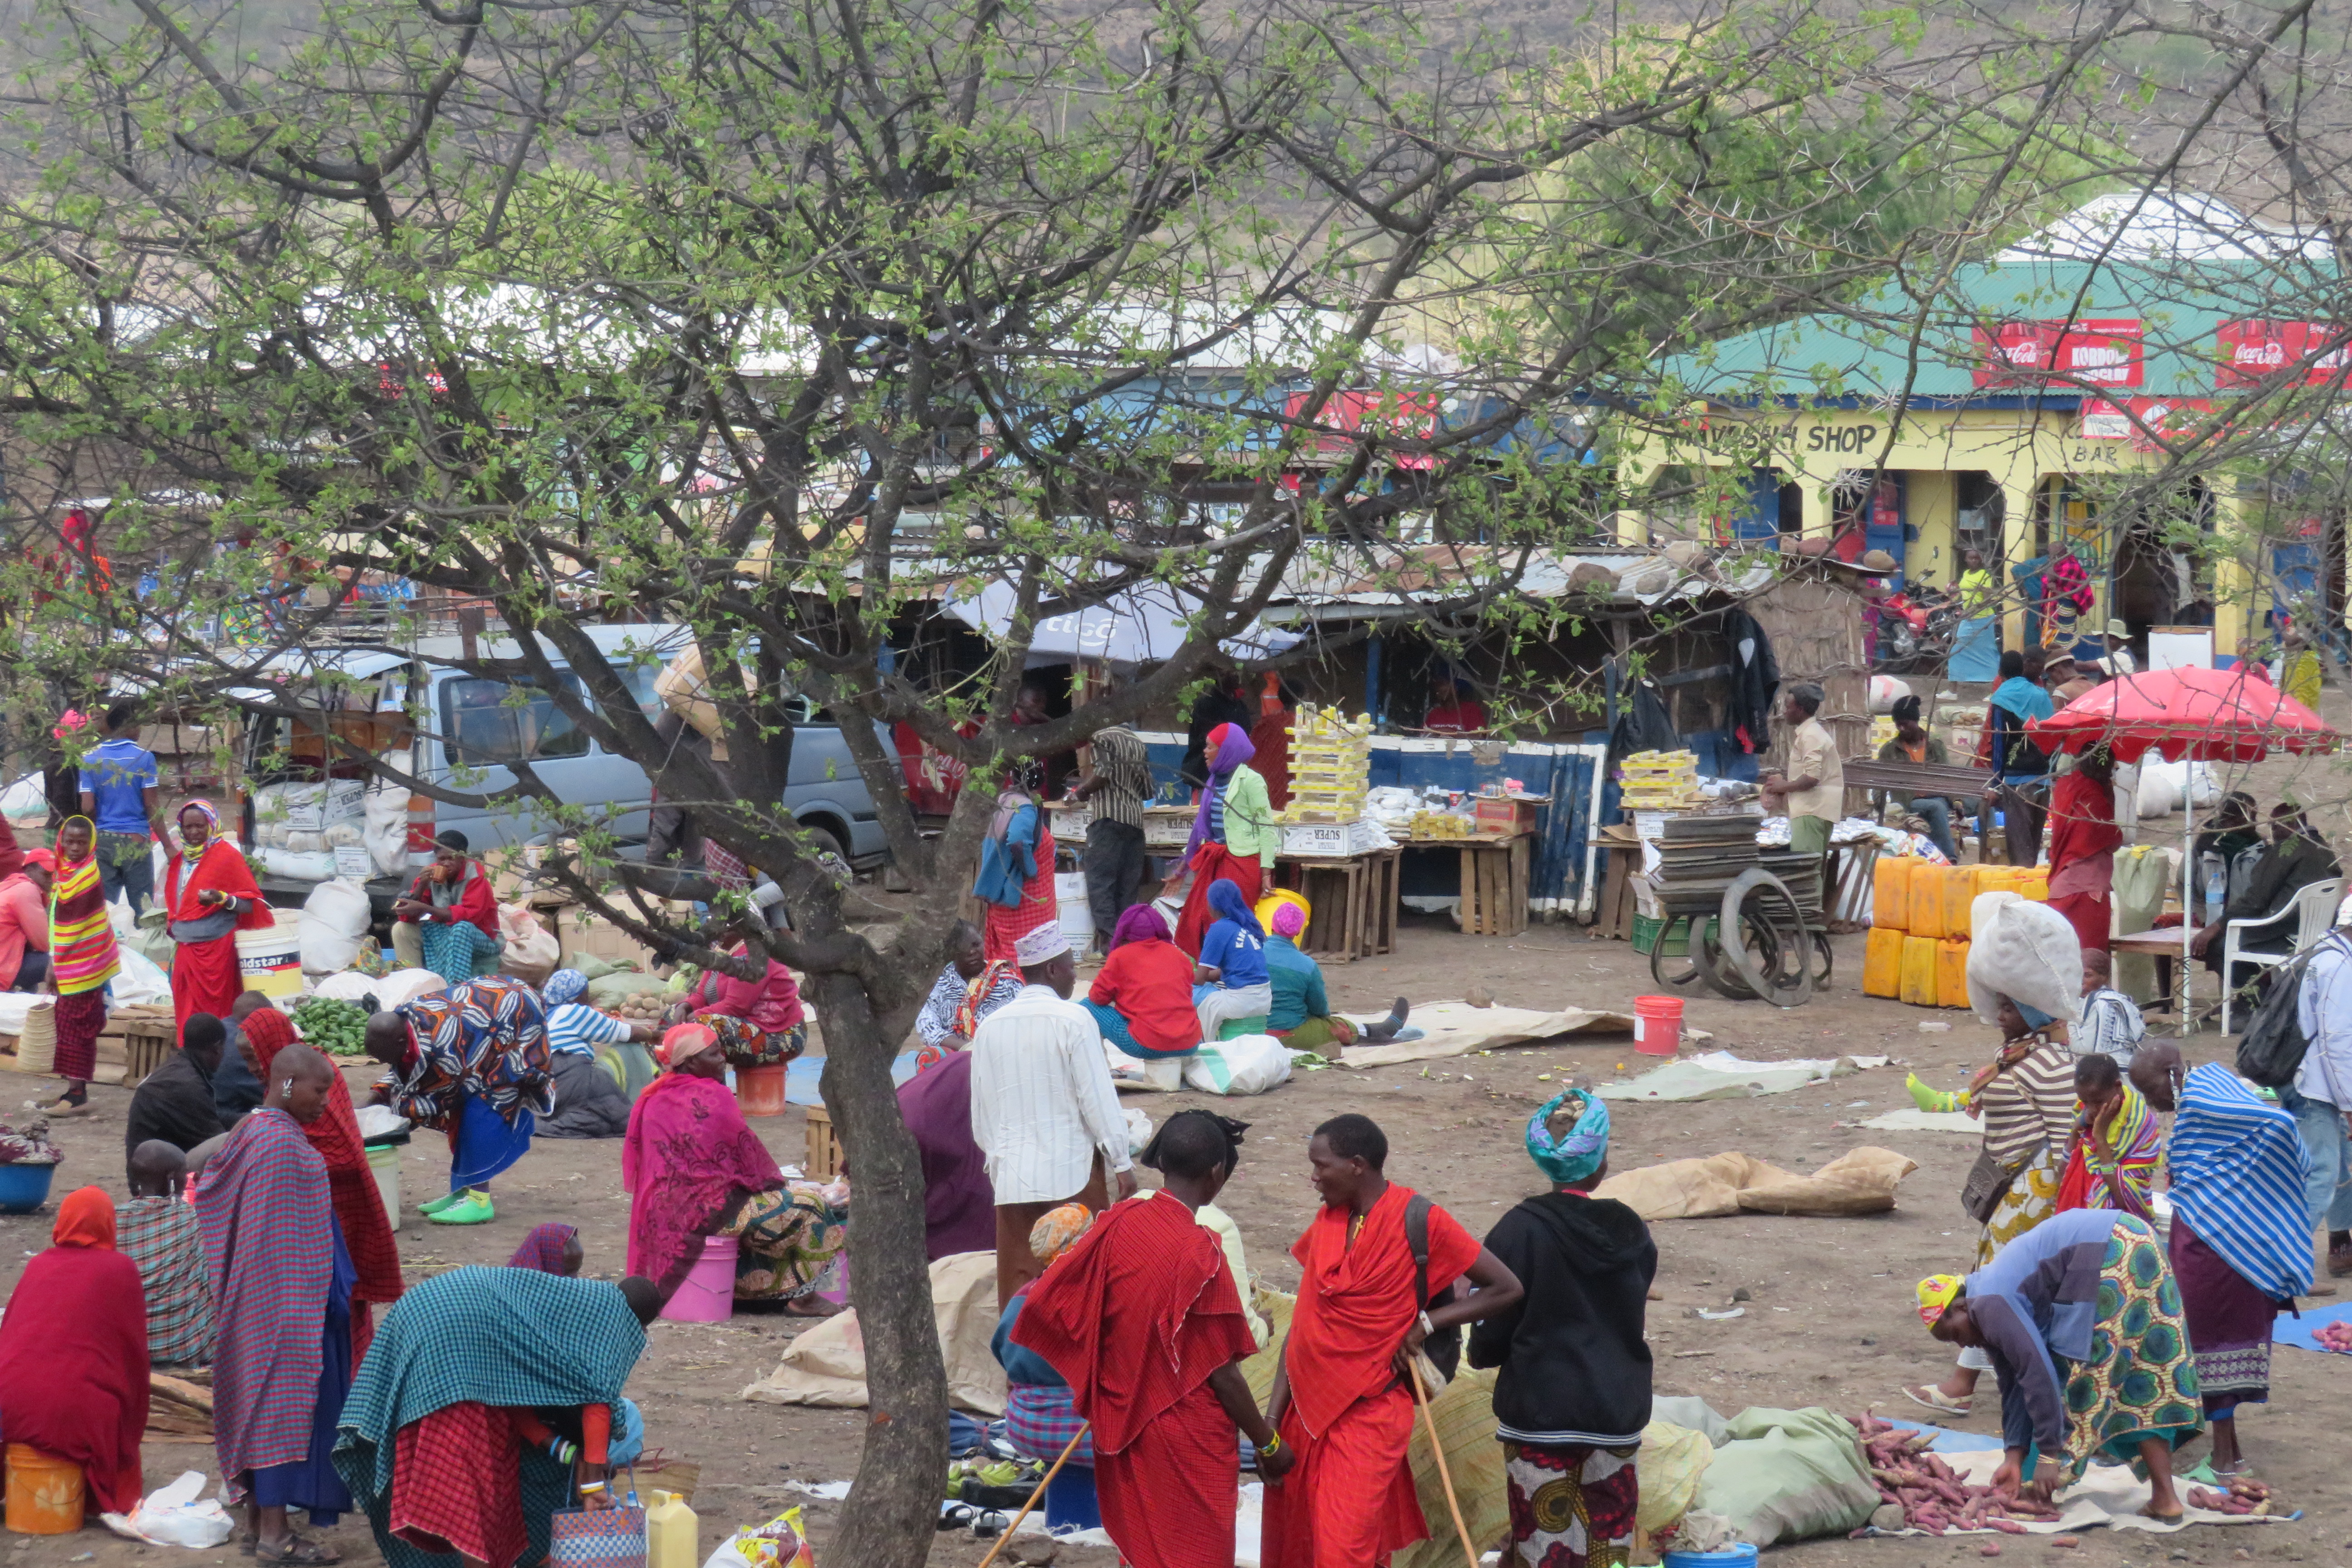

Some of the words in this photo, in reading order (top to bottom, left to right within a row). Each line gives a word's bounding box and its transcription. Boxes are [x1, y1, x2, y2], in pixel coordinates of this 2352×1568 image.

[1808, 425, 1877, 454] SHOP
[2073, 446, 2117, 462] BAR
[1314, 829, 1341, 840] SUPER
[240, 956, 283, 969] oldstar
